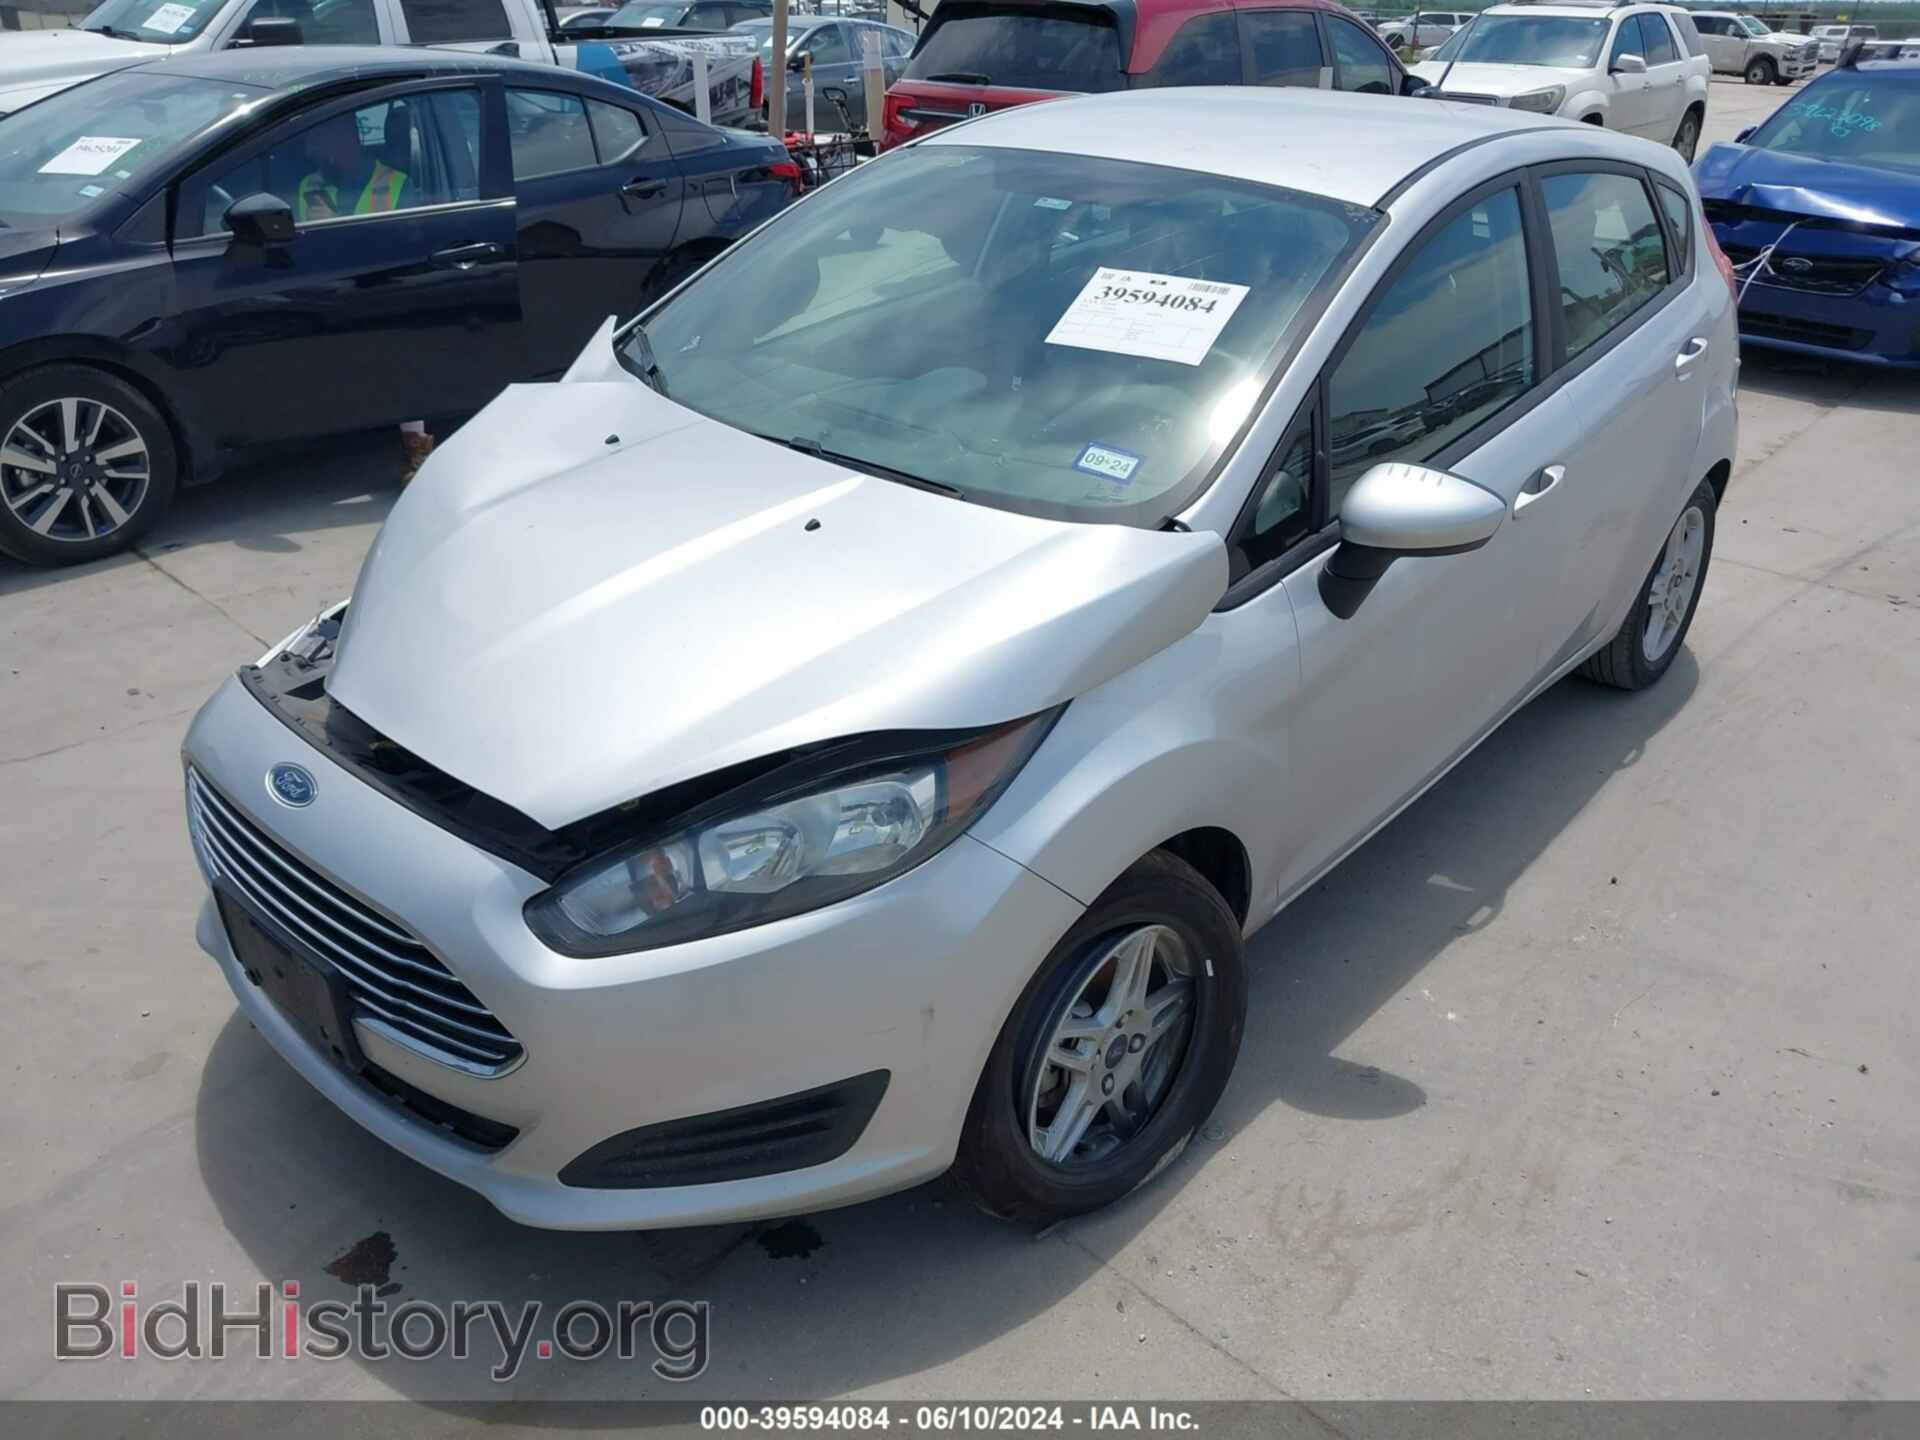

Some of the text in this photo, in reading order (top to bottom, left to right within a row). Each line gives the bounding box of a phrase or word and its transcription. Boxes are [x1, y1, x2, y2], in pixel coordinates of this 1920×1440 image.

[1094, 285, 1219, 314] 39594084
[1084, 452, 1131, 473] 09 24
